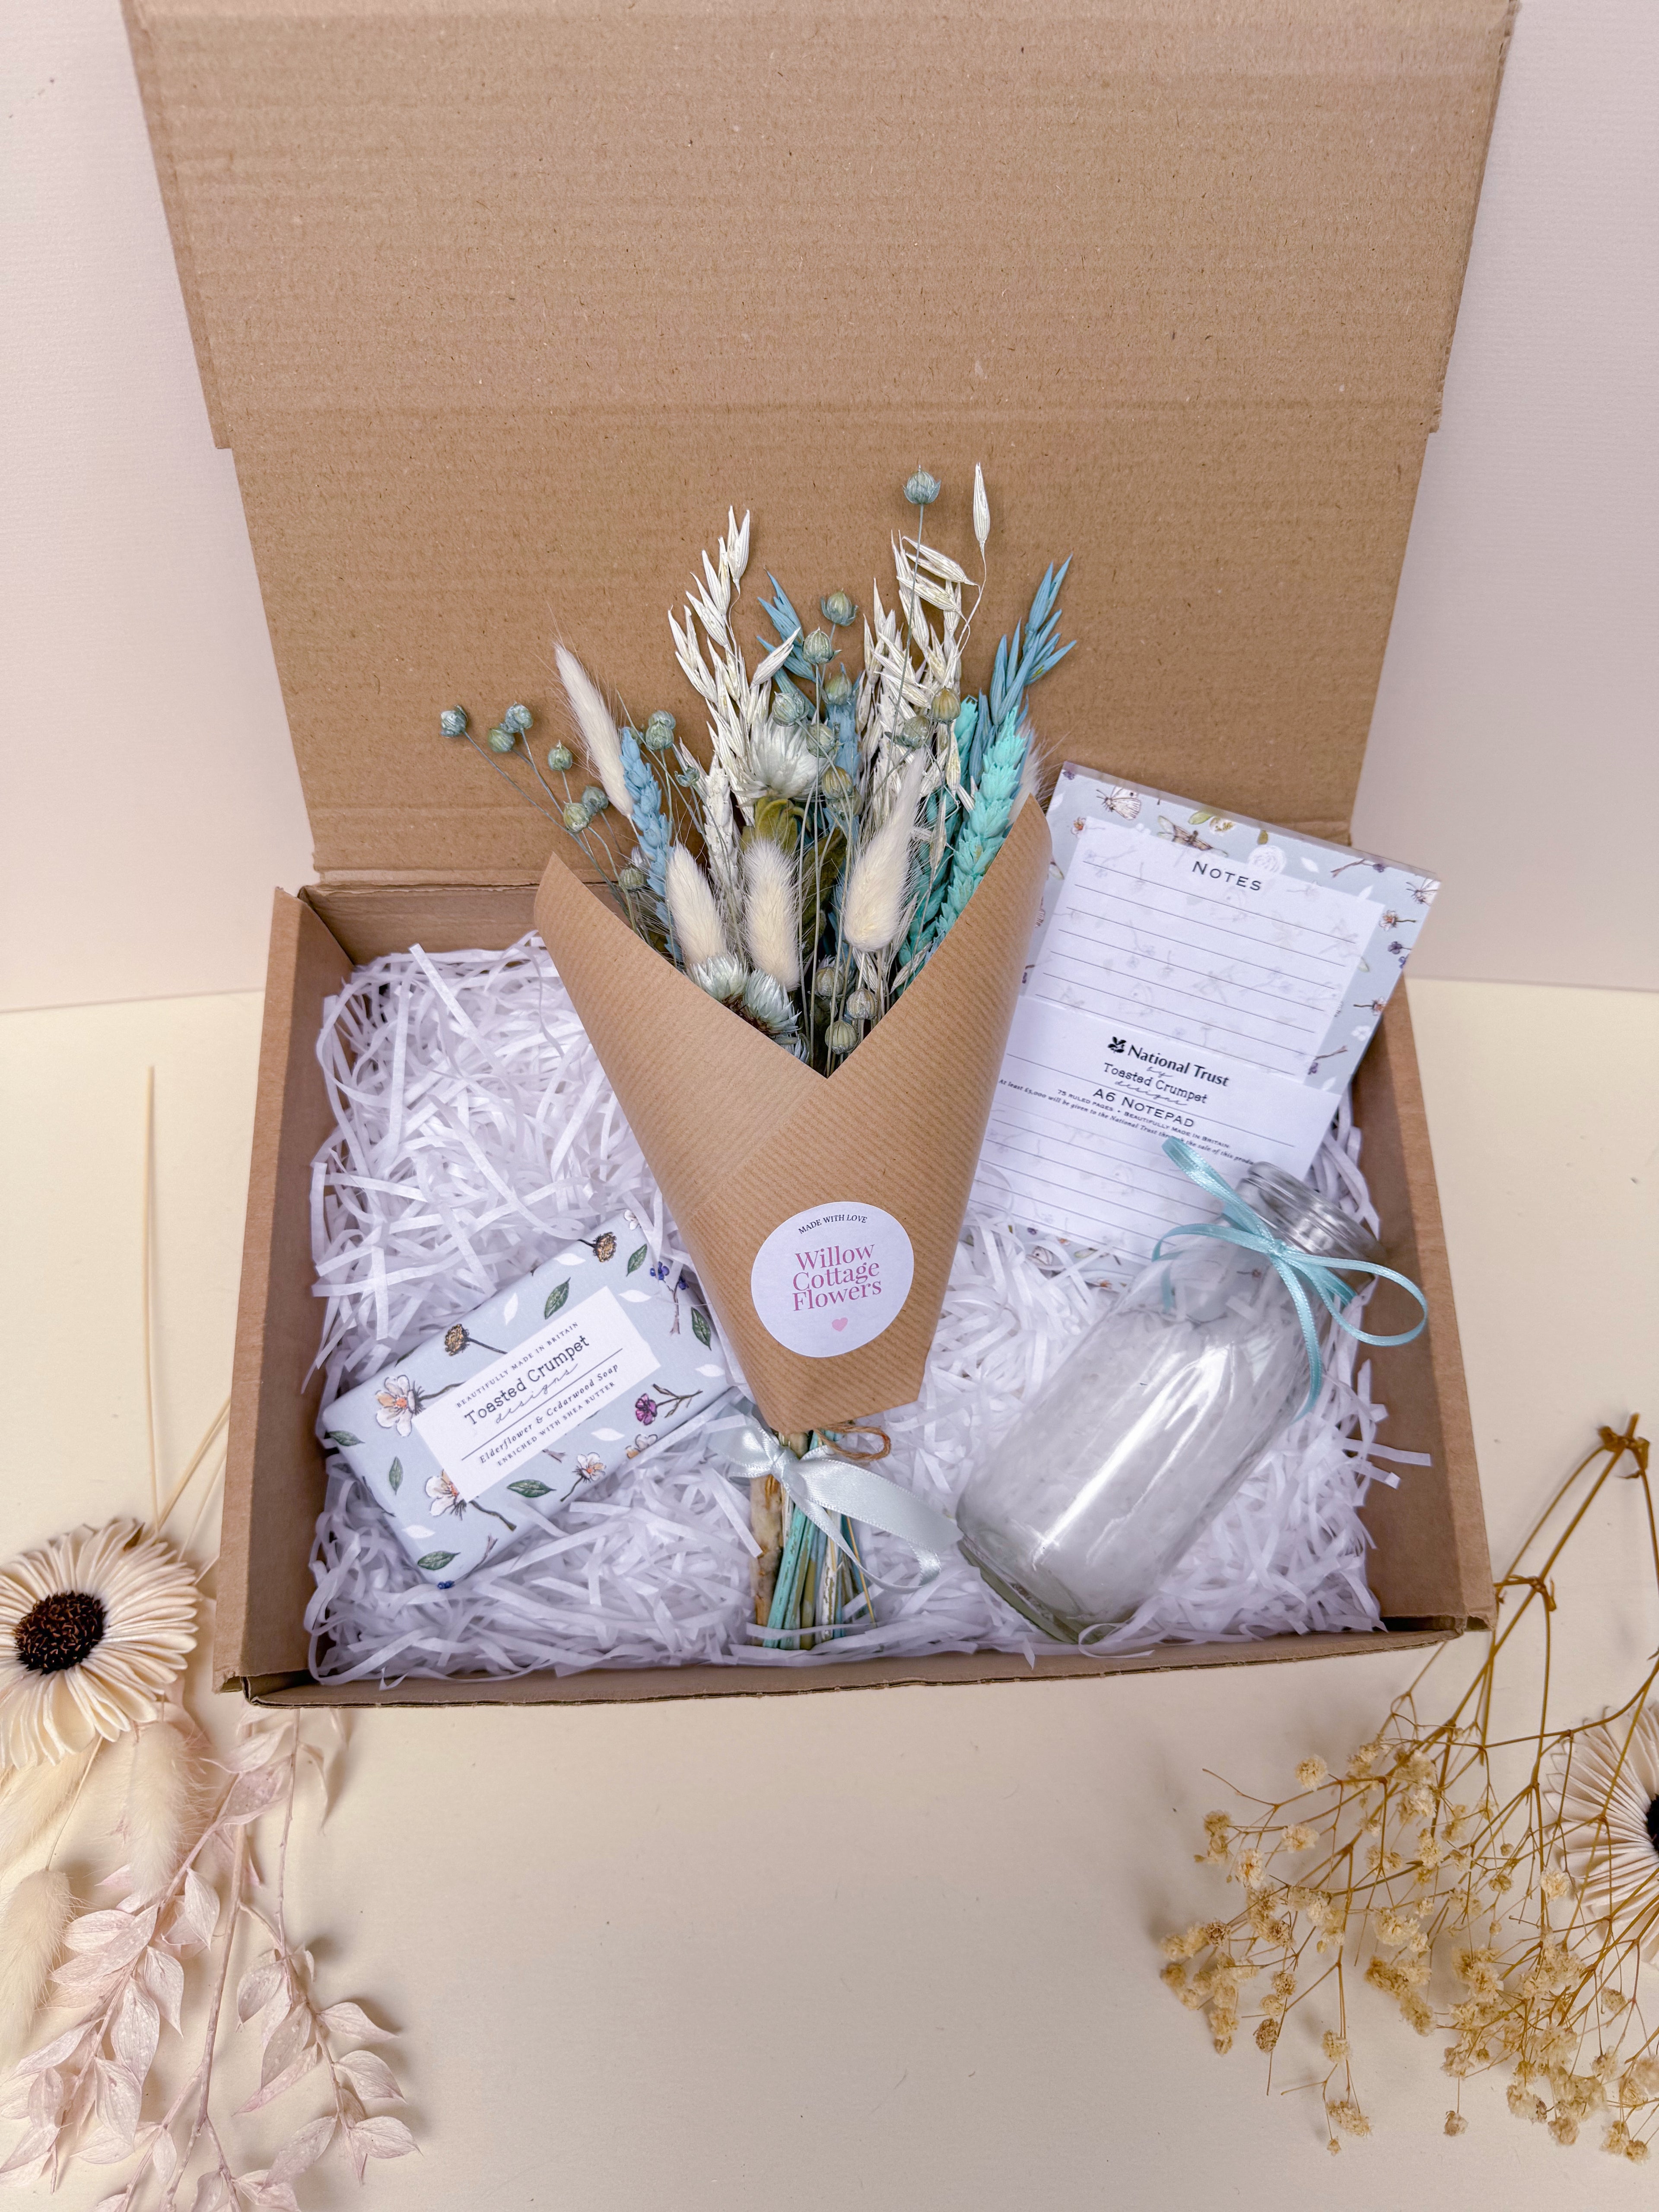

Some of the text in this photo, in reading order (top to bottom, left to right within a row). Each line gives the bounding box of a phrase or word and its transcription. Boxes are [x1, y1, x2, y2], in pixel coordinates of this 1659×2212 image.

[1192, 861, 1262, 891] NOTES
[1104, 1062, 1208, 1104] Toasted Crumpet
[1128, 1045, 1230, 1087] National Trust
[1068, 1093, 1090, 1104] RULED
[1092, 1102, 1114, 1112] PAGES
[1093, 1088, 1194, 1128] A6 NOTEPAD
[1115, 1081, 1188, 1106] designs
[1007, 1081, 1023, 1090] least
[1070, 1103, 1089, 1112] given
[1098, 1110, 1109, 1119] the
[1110, 1115, 1138, 1129] National
[1139, 1125, 1157, 1135] Trust
[1220, 1150, 1233, 1158] this
[1233, 1156, 1254, 1165] produ
[798, 1214, 868, 1234] MADE WITH LOVE
[792, 1262, 880, 1291] Cottage
[795, 1244, 875, 1271] Willow
[792, 1281, 882, 1312] Flowers
[456, 1322, 578, 1408] BEAUTIFULLY MADE IN BRITAIN
[464, 1335, 590, 1425] Toasted Crumpet
[480, 1424, 532, 1464] Elderflower
[547, 1379, 594, 1416] Cedarwood
[597, 1364, 618, 1381] Soap
[496, 1363, 578, 1424] designs
[497, 1382, 615, 1466] ENRICHED WITH SHEA BUTTER
